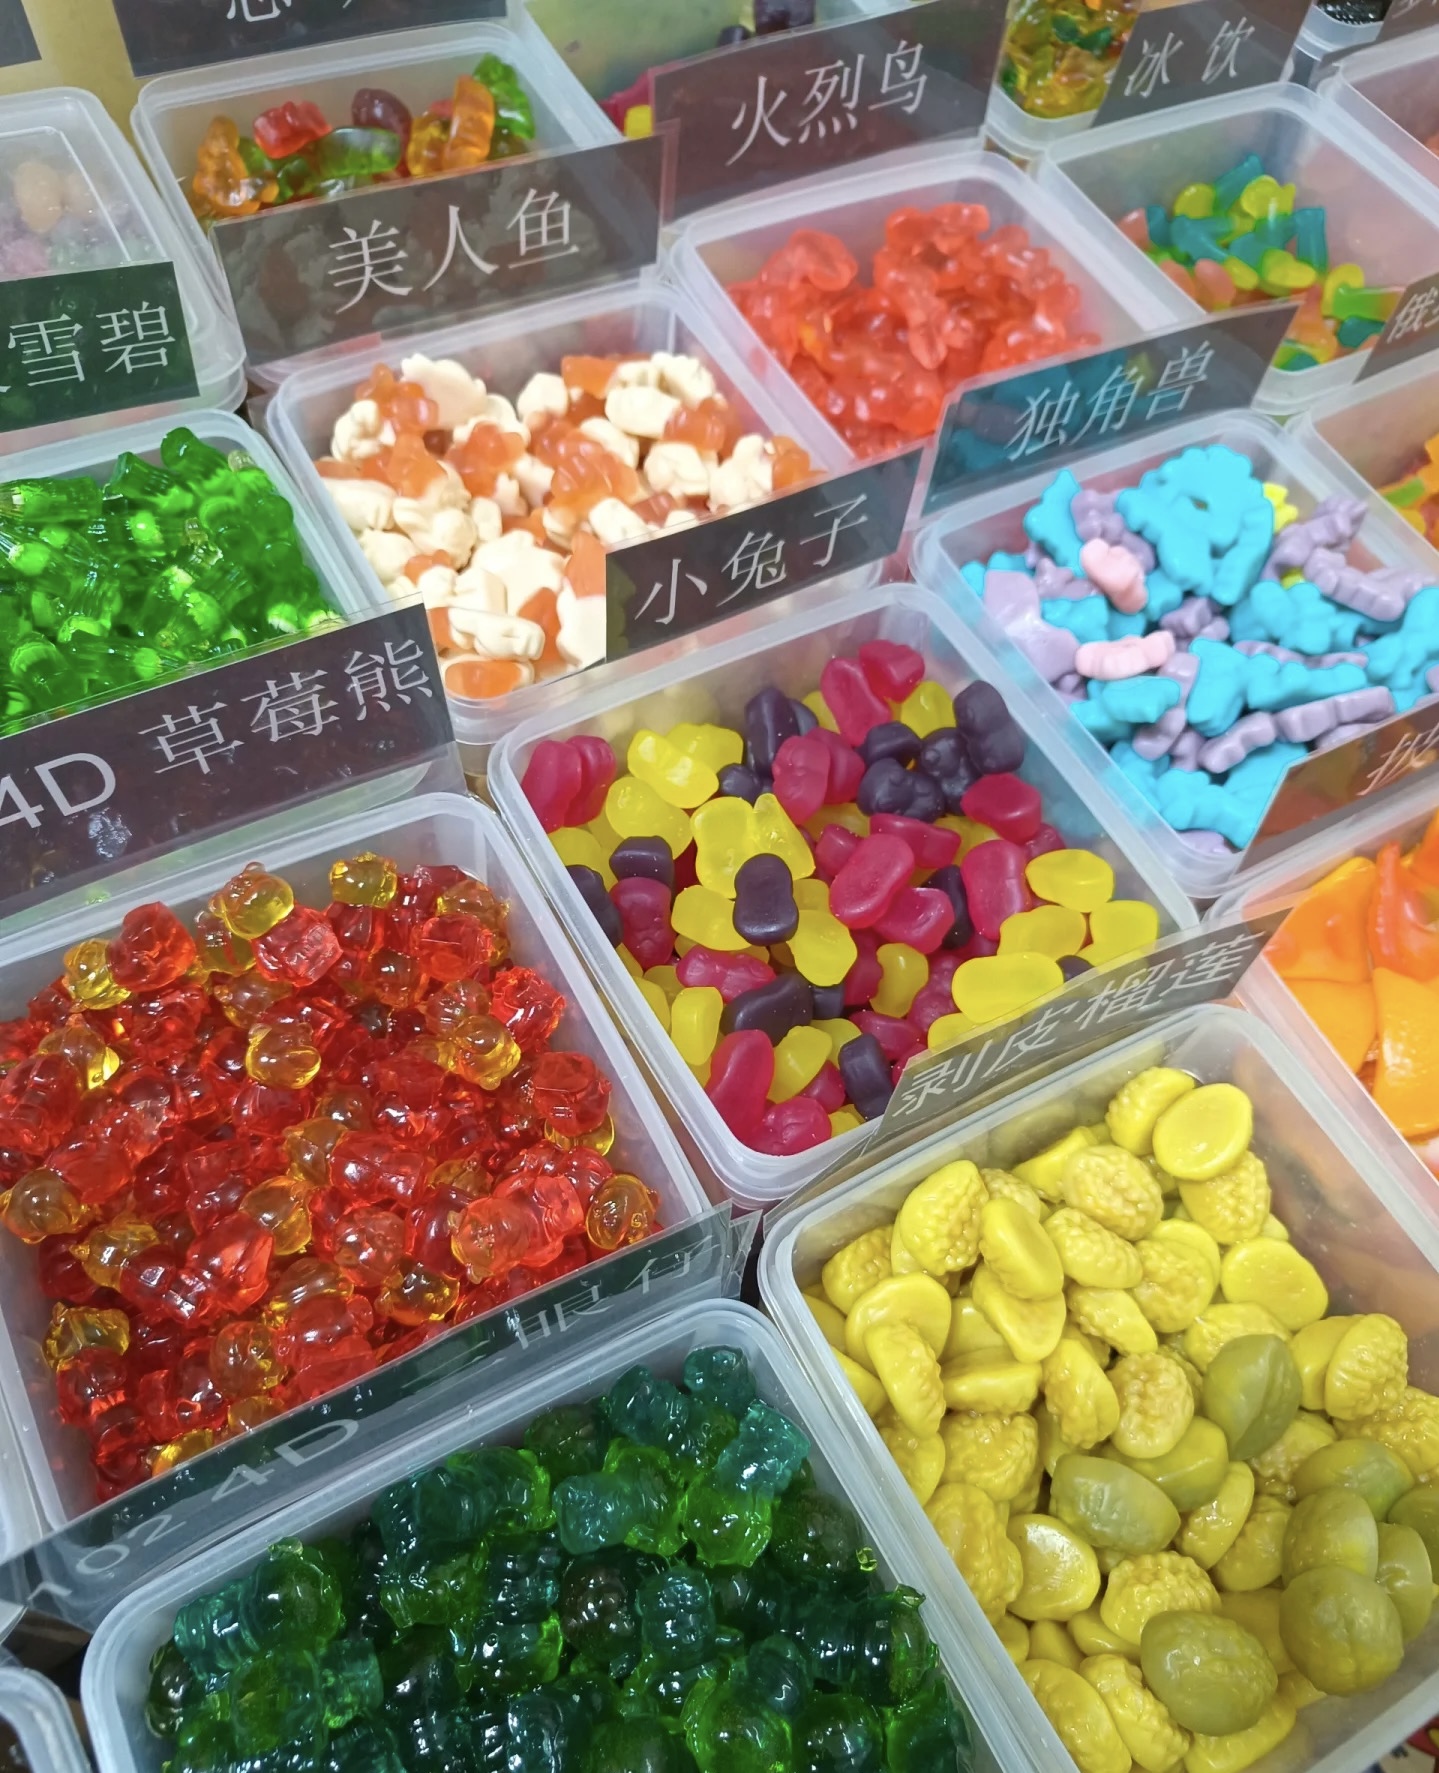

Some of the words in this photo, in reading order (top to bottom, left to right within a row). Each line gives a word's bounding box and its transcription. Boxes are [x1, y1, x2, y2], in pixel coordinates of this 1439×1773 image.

[725, 39, 928, 167] 火烈鸟
[328, 188, 580, 315] 美人鱼
[0, 301, 176, 393] 雪碧
[1003, 340, 1215, 462] 独角兽
[634, 493, 868, 625] 小兔子
[0, 752, 117, 829] 4D
[137, 638, 434, 776] 草莓熊
[891, 930, 1266, 1118] 剥皮榴莲
[211, 1418, 360, 1502] 4D
